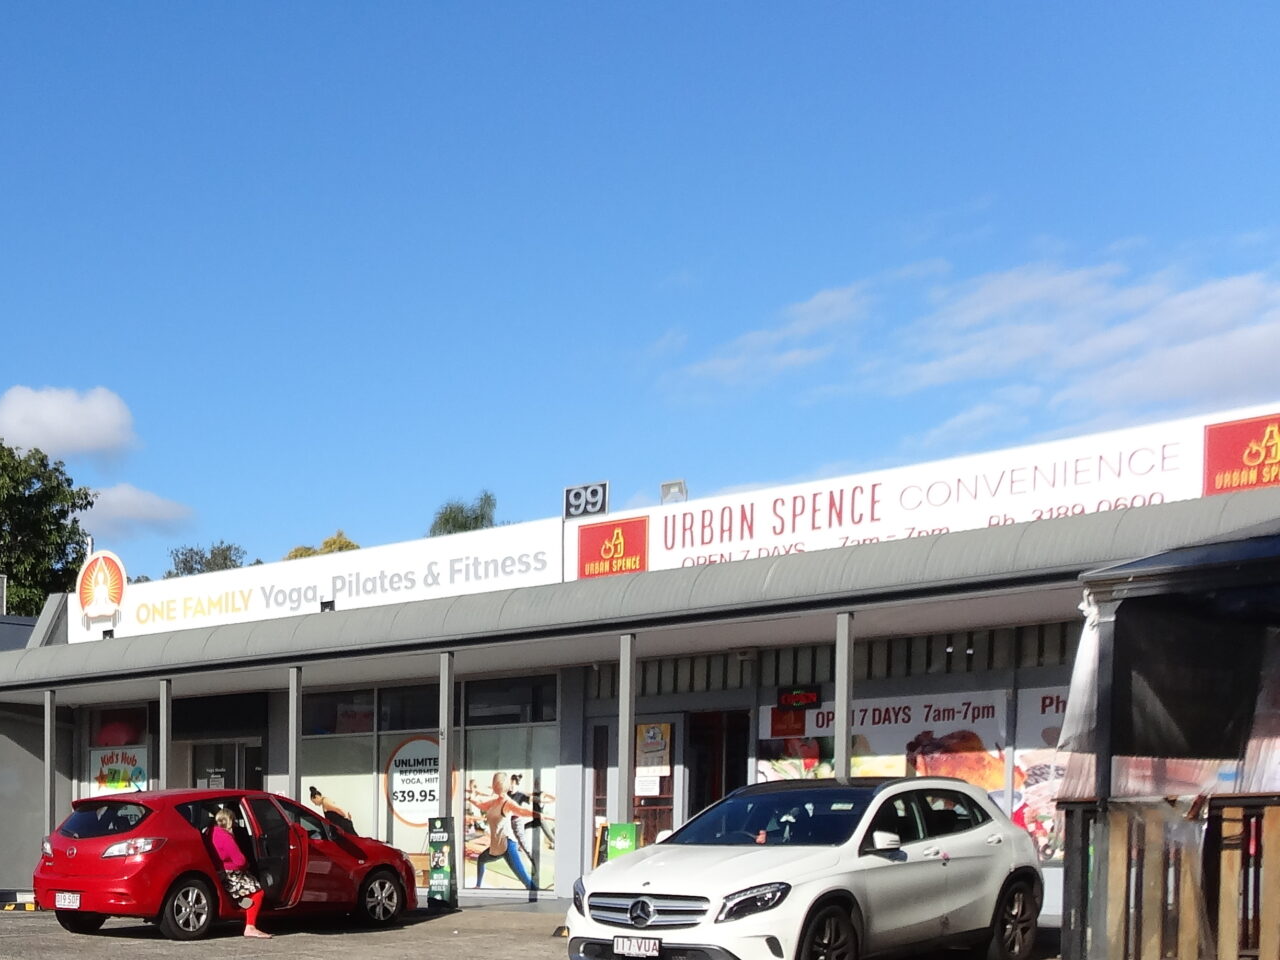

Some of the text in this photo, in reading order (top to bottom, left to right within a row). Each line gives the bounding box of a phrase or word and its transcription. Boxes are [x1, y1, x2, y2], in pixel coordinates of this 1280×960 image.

[1214, 467, 1259, 490] URBAN
[568, 484, 605, 517] 99
[663, 441, 1181, 551] URBAN SPENCE CONVENIENCE
[584, 554, 641, 576] URBAN SPENCE
[135, 550, 548, 625] ONE FAMILY Yoga, Pilates & Fitness
[871, 705, 913, 726] DAYS
[923, 702, 996, 723] 7am-7pm
[100, 751, 138, 768] Kid's Hub
[394, 757, 439, 768] UNLIMITE
[400, 777, 423, 785] YOGA,
[616, 938, 659, 953] 117 VUA
